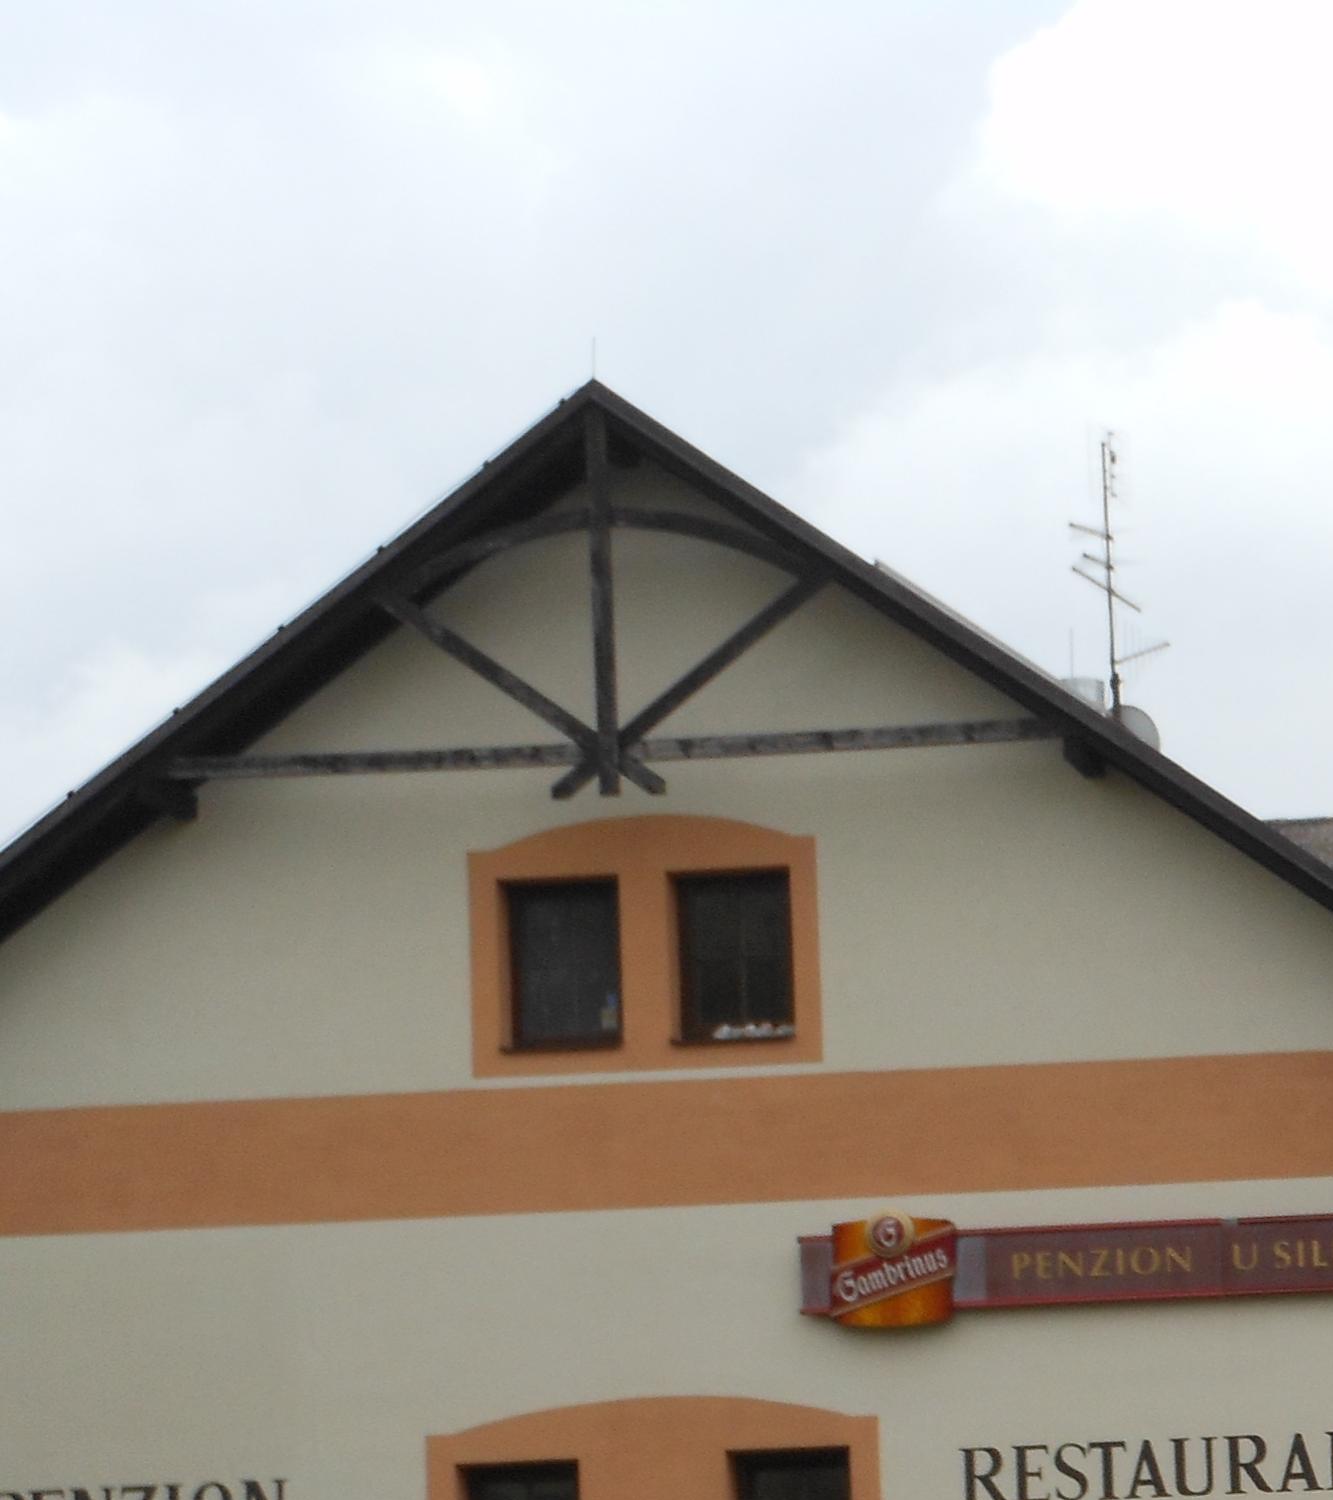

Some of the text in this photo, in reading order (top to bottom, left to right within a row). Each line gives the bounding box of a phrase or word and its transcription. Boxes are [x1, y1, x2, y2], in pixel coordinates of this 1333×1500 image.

[835, 1247, 949, 1303] Gambrinus
[1011, 1245, 1194, 1281] PENZION
[1232, 1242, 1259, 1272] U
